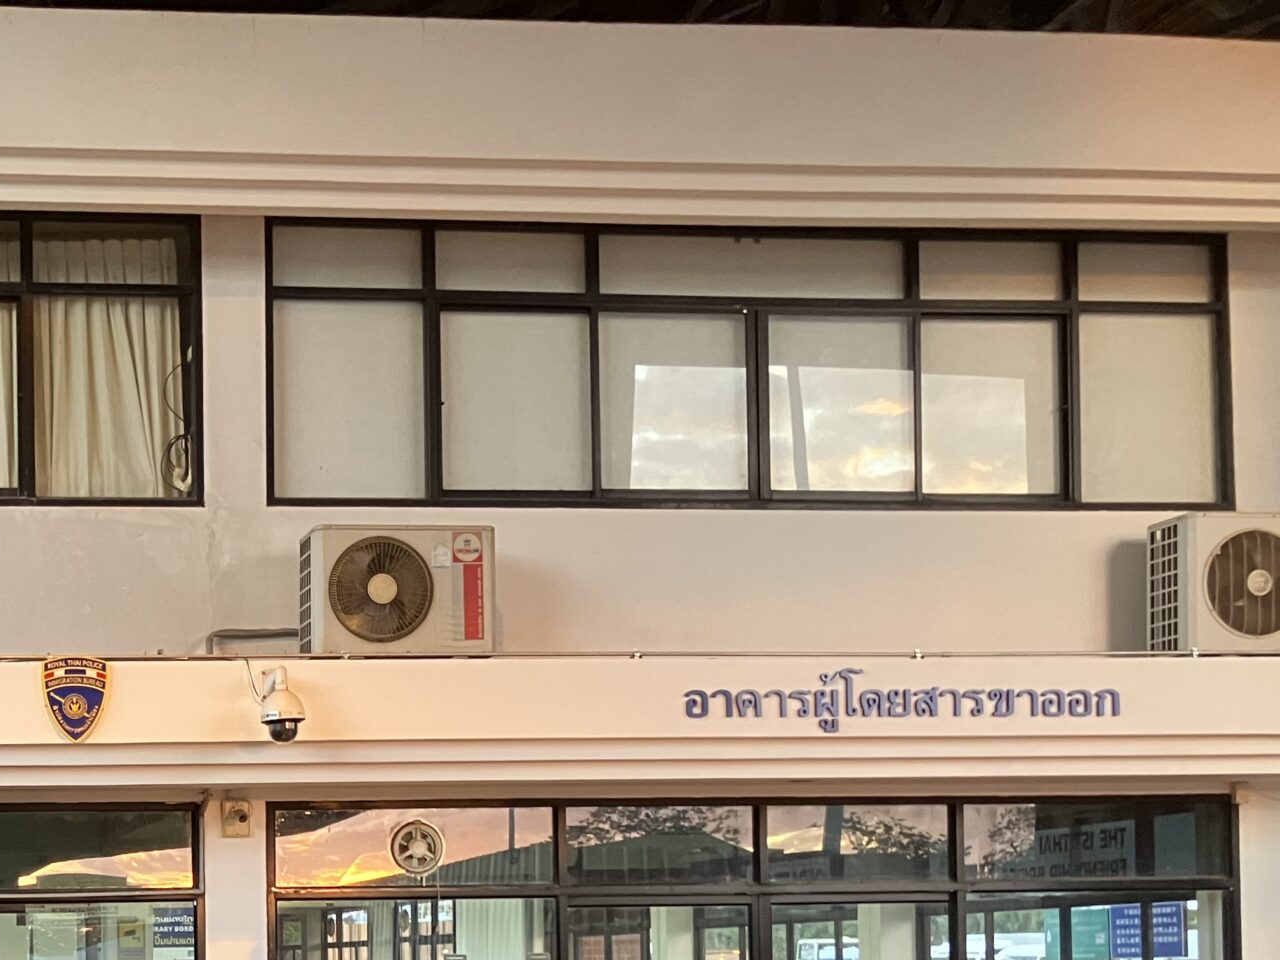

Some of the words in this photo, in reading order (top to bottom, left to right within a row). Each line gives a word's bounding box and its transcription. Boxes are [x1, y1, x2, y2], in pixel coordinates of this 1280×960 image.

[47, 660, 66, 669] ROYAL
[82, 660, 103, 669] POLICE
[684, 668, 1121, 733] อาคารผู้โดยสารขาออก
